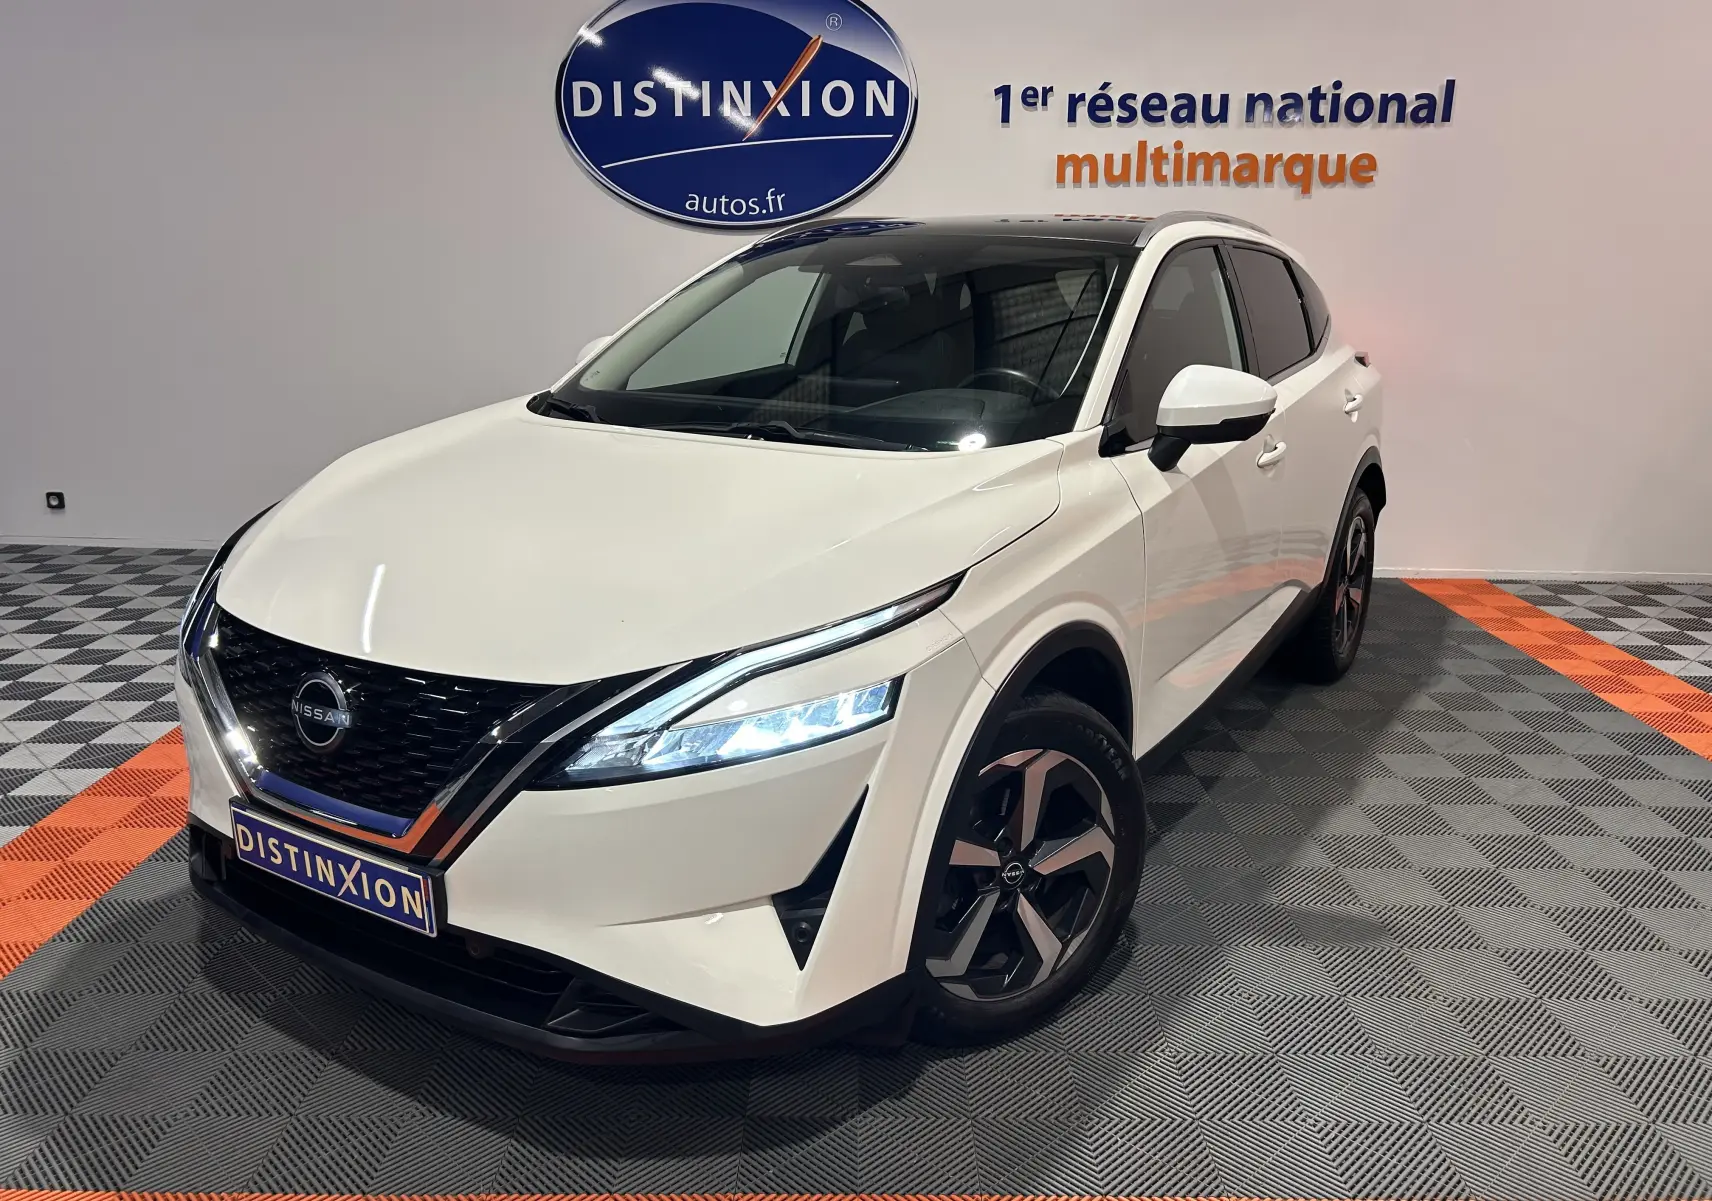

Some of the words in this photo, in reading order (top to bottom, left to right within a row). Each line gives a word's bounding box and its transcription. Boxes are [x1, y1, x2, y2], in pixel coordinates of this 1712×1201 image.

[993, 83, 1054, 124] 1er
[1067, 81, 1230, 125] réseau
[1244, 78, 1456, 125] national
[1055, 139, 1378, 195] multimarque
[685, 187, 786, 216] autos.fr
[291, 698, 350, 726] NISSAN
[236, 823, 424, 920] DISTINXION
